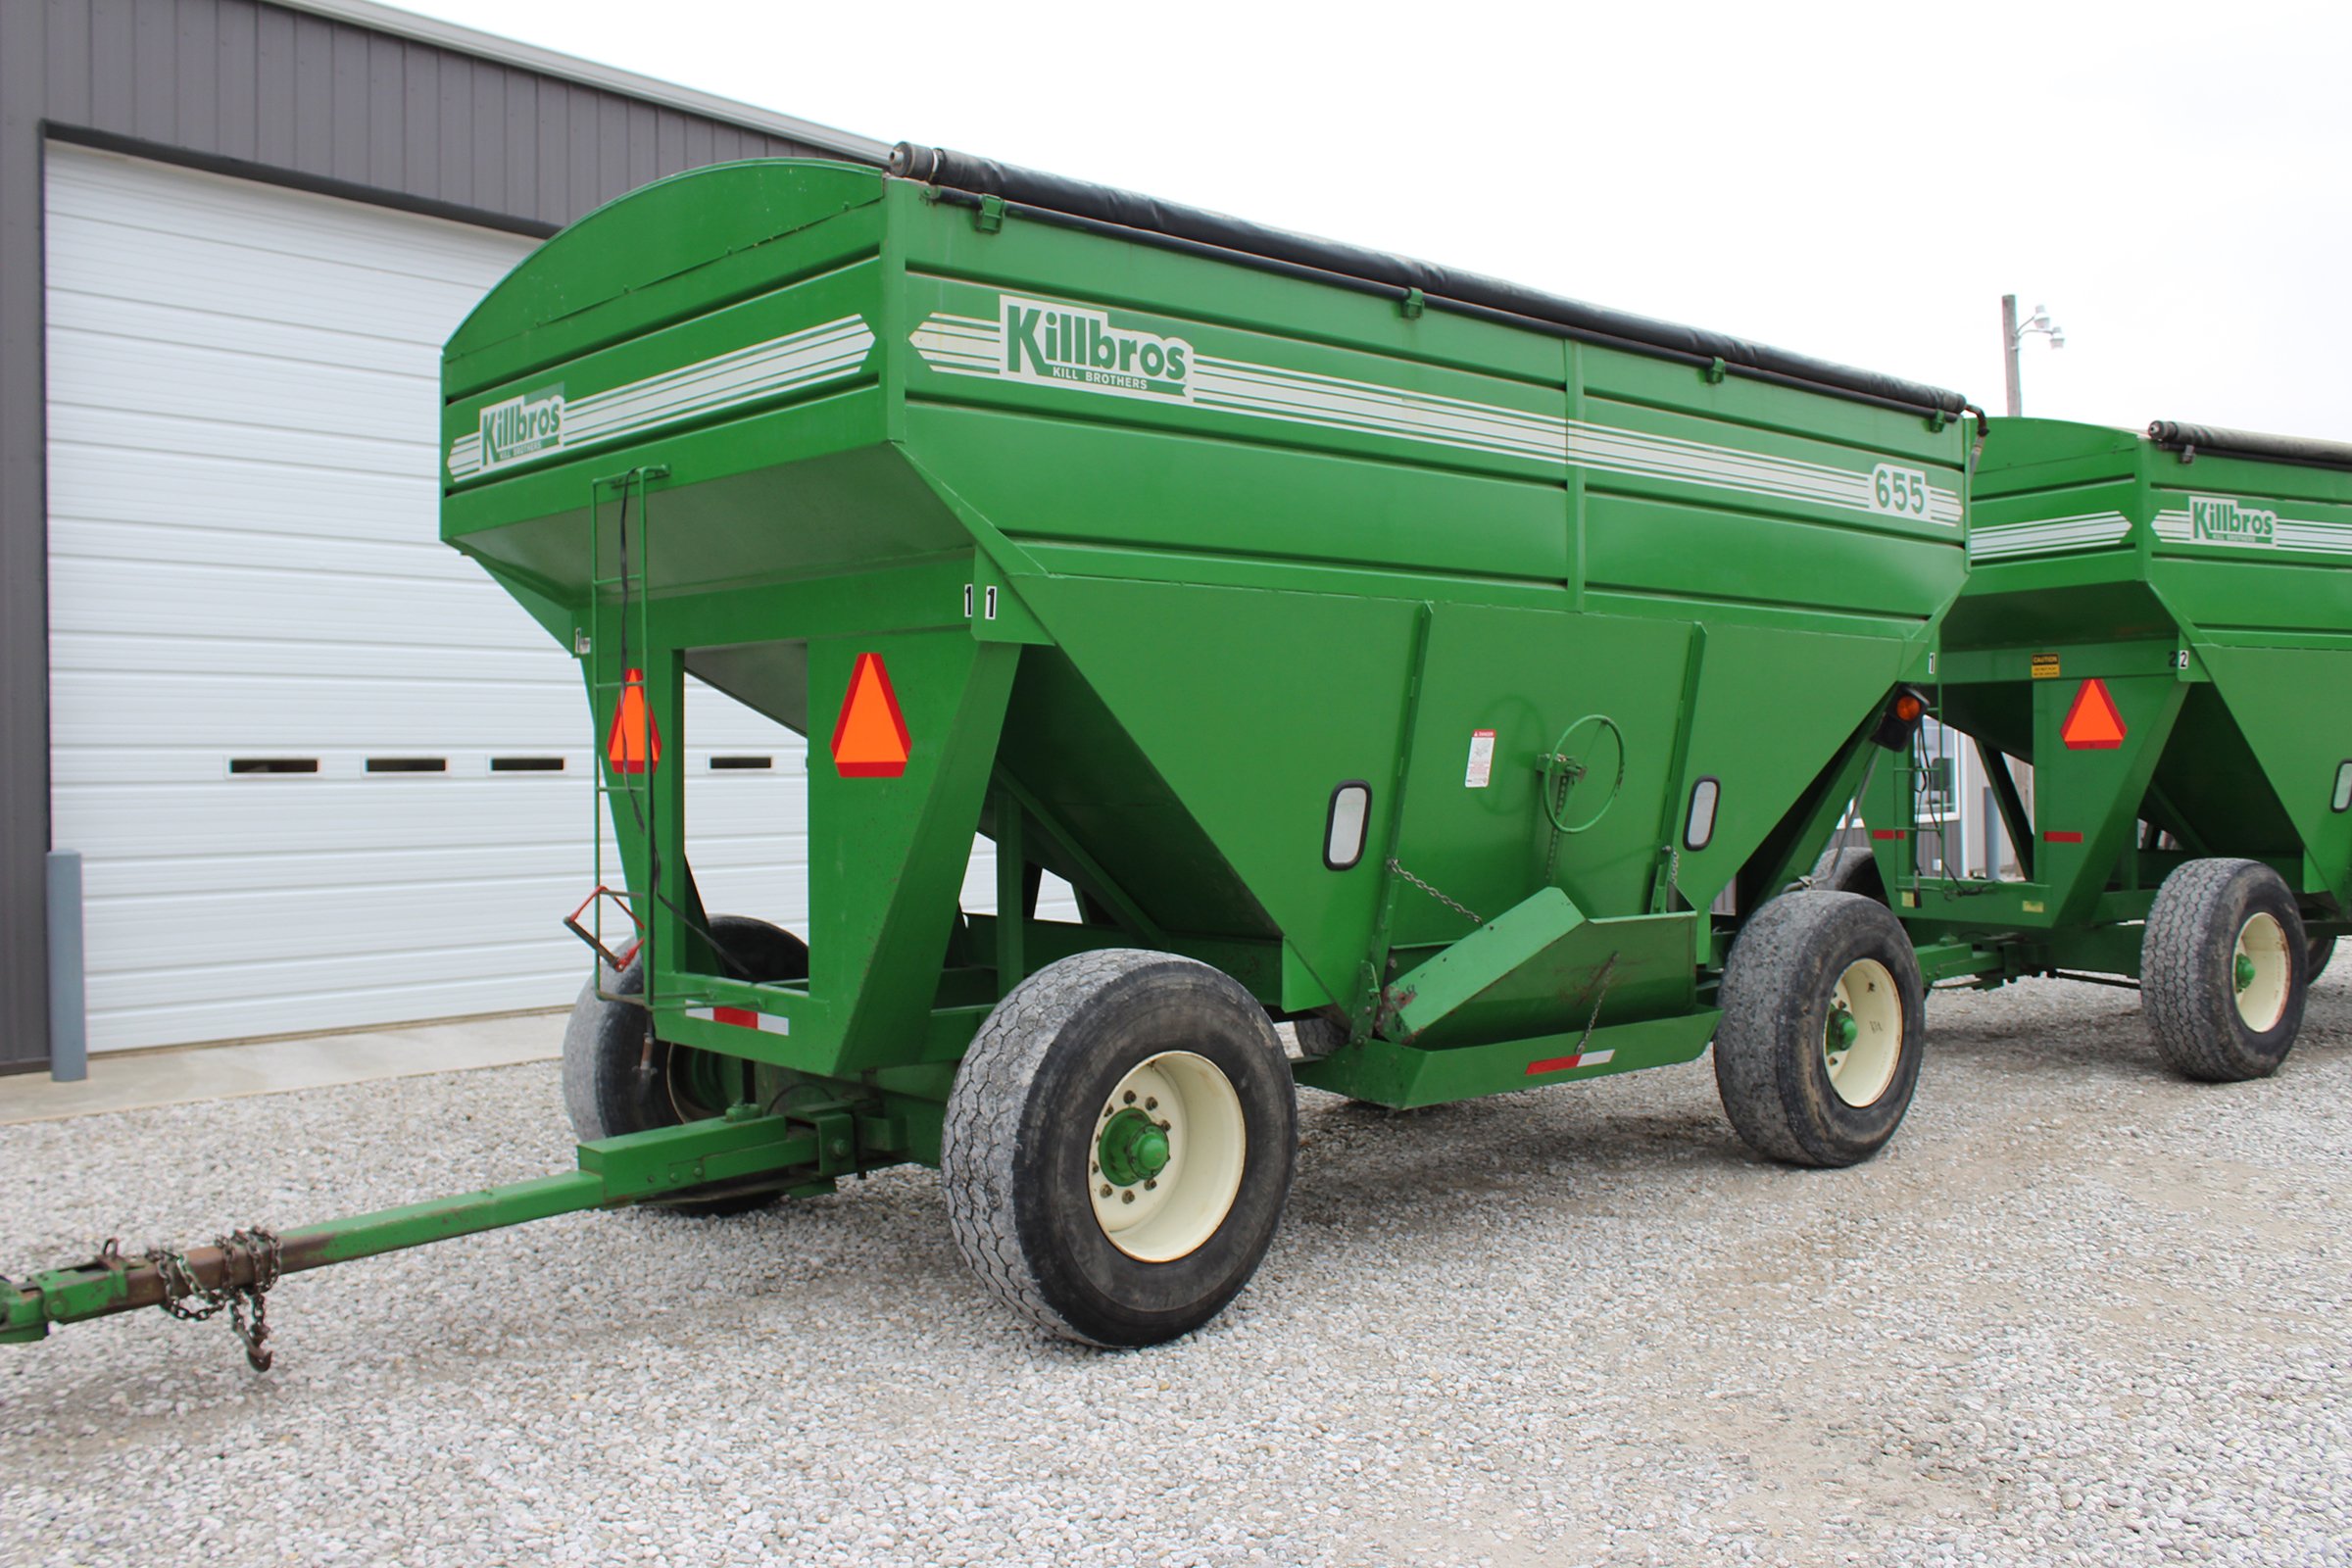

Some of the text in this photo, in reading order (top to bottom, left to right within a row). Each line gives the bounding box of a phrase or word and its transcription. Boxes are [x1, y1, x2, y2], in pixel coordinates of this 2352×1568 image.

[1007, 305, 1186, 380] Killbros
[1053, 367, 1148, 389] KILL BROTHERS
[482, 403, 560, 466] Killbros
[1876, 469, 1925, 514] 655
[2193, 502, 2273, 539] Killbros
